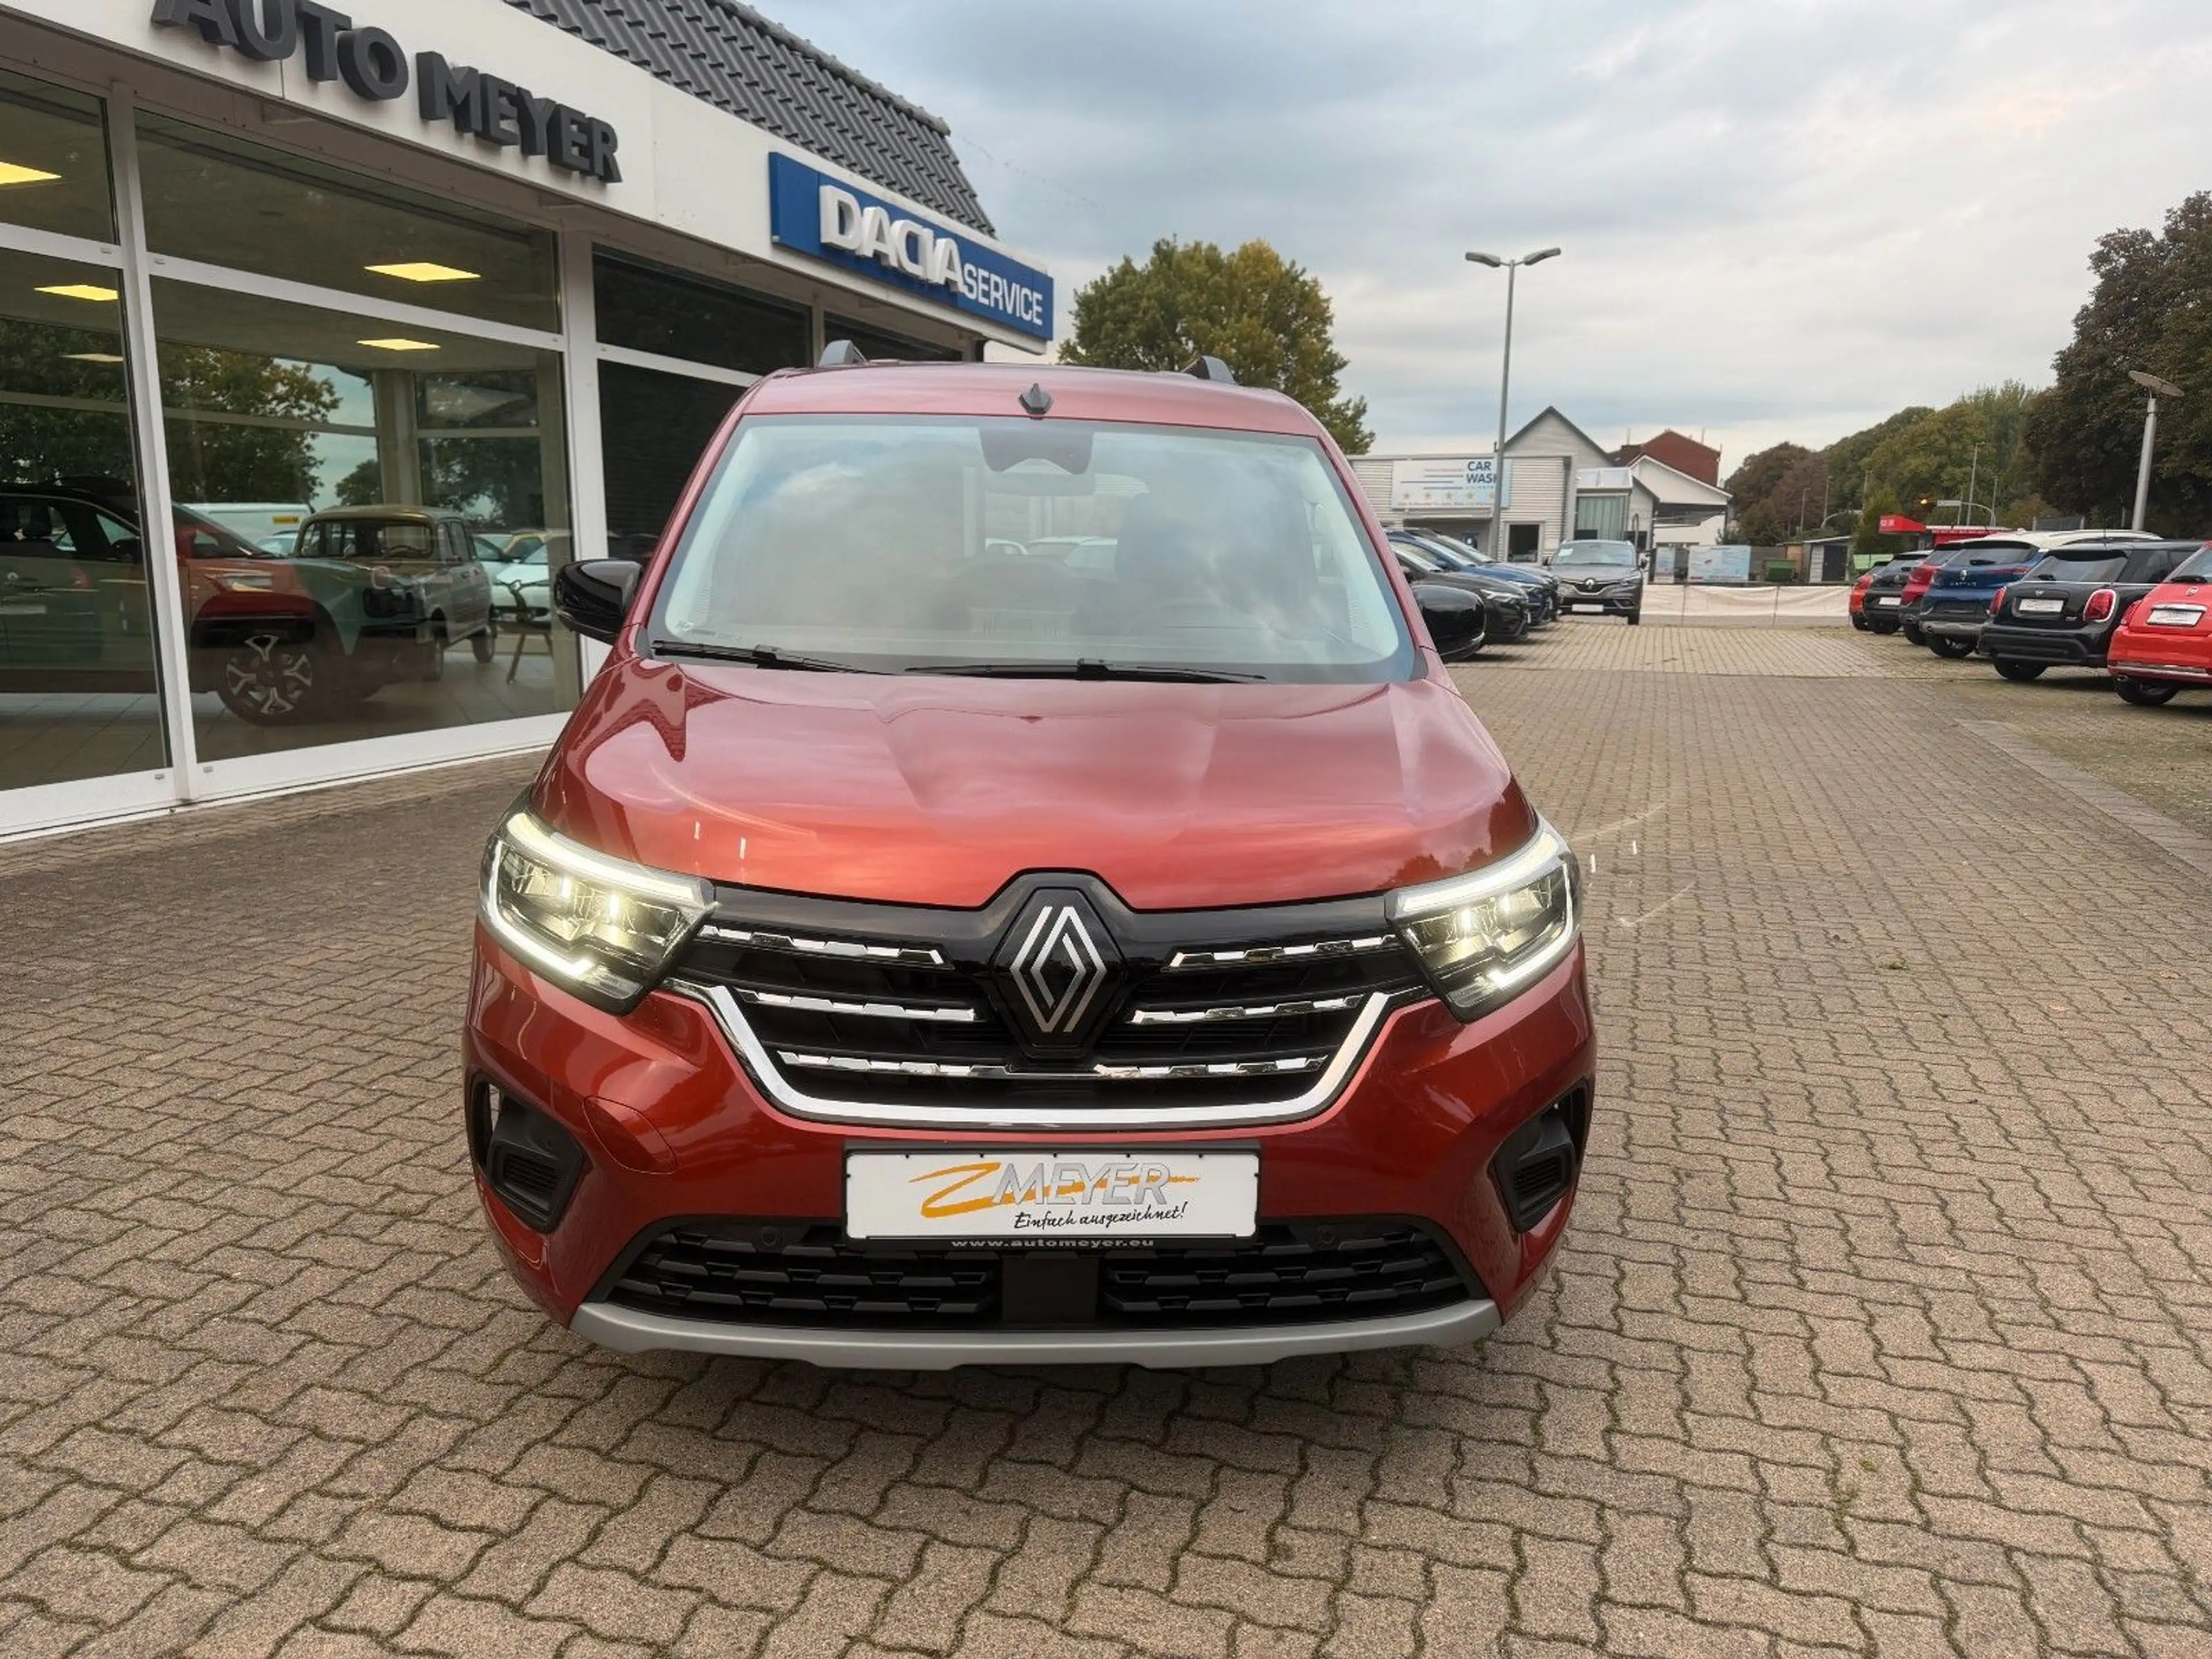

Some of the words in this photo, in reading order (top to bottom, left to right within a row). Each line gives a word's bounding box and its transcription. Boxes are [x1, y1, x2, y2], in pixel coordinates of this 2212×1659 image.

[416, 51, 623, 183] MEYER
[820, 184, 965, 293] DACIA
[964, 264, 1043, 325] SERVICE
[1468, 461, 1491, 471] CAR
[992, 1162, 1171, 1205] MEYER
[1014, 1210, 1077, 1230] Einfach
[1079, 1202, 1188, 1228] ausgezeichnet!
[951, 1238, 1154, 1248] www.automeyer.eu
